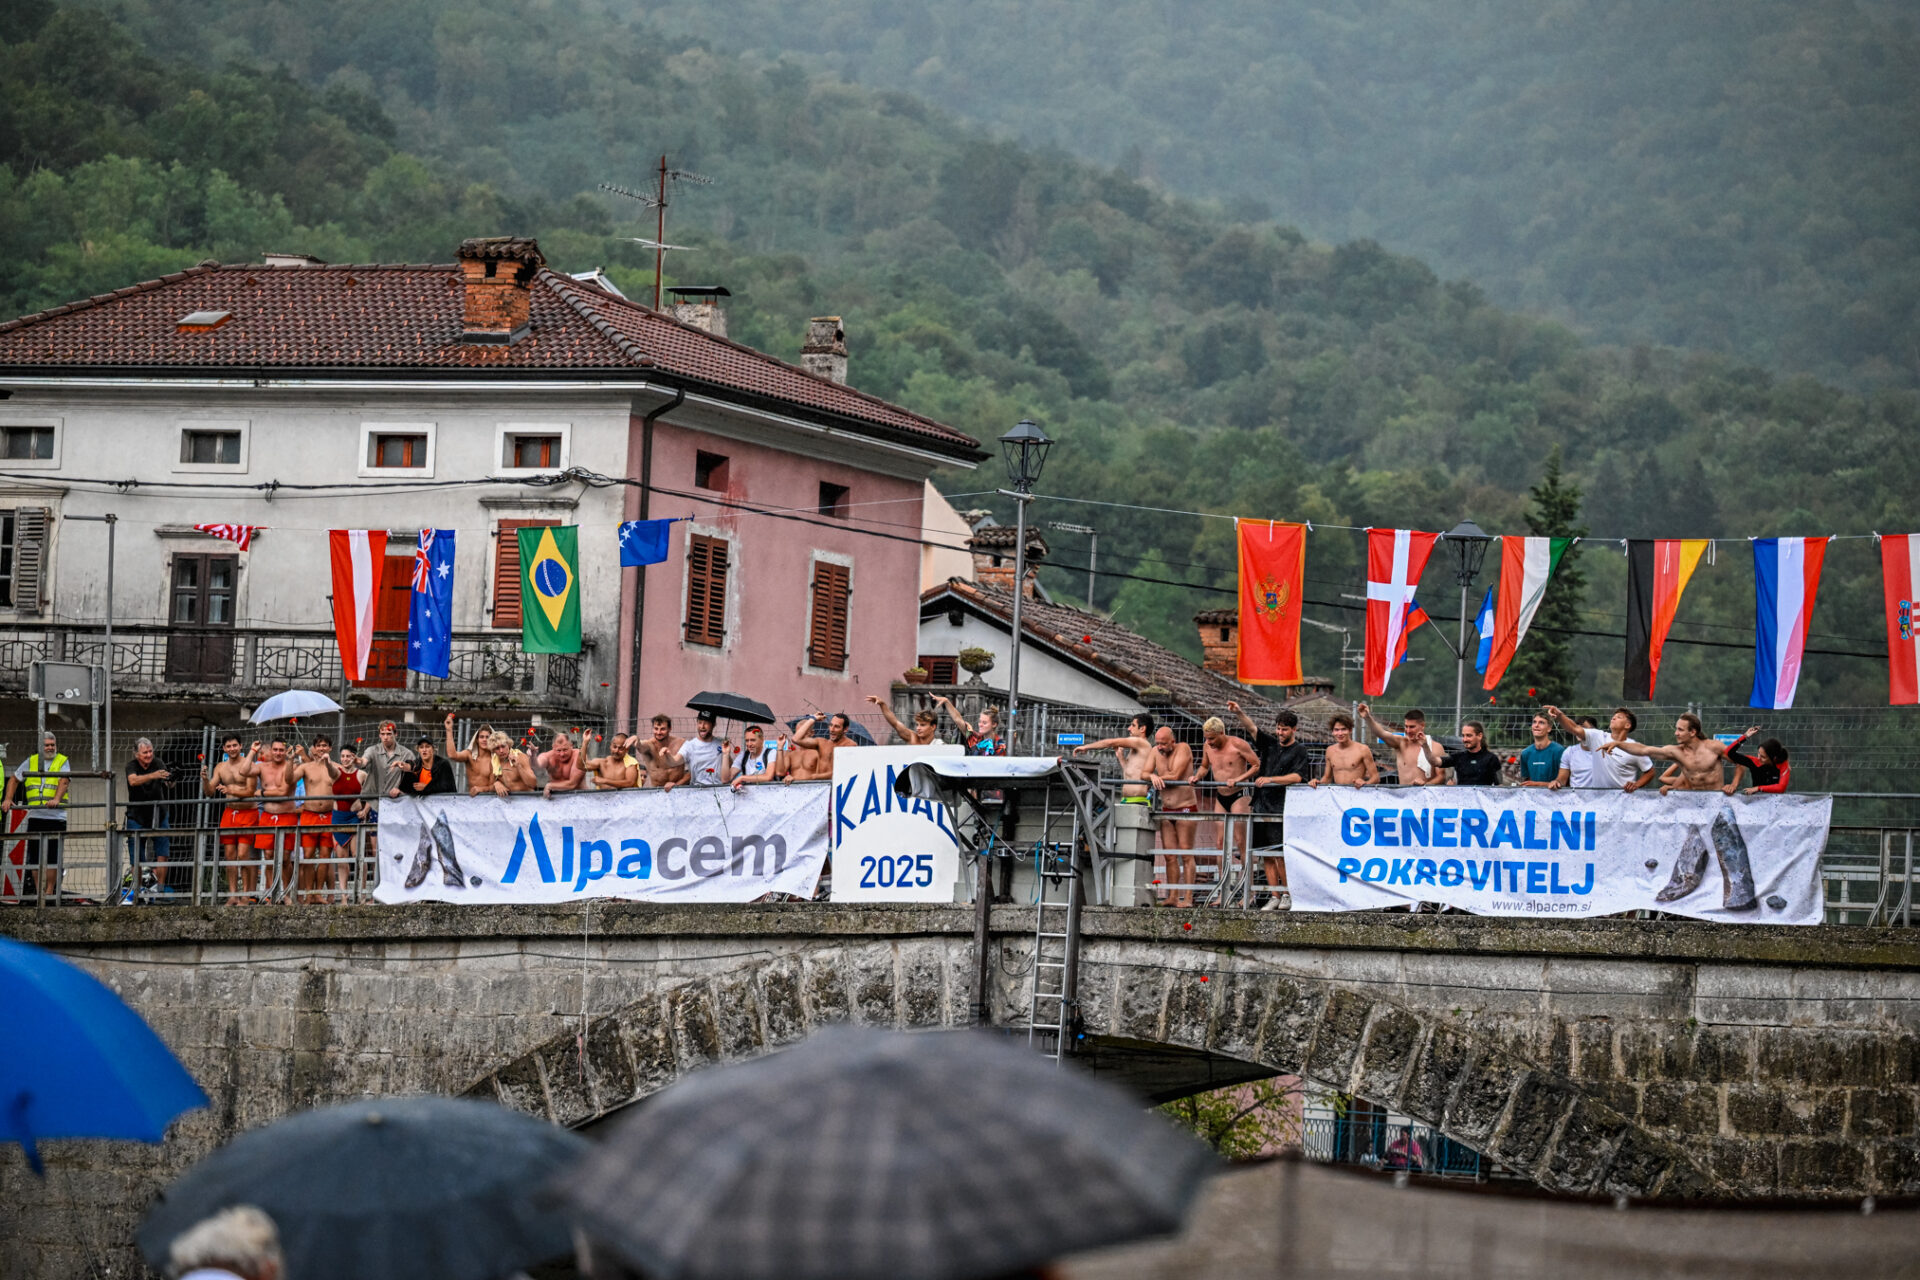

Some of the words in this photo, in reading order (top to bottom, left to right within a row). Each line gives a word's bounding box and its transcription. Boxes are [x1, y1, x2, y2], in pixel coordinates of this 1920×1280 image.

[1341, 807, 1596, 851] GENERALNI
[500, 811, 787, 892] Alpacem
[860, 855, 933, 888] 2025
[1337, 857, 1595, 895] POKROVITELJ
[1492, 899, 1592, 914] www.alpacem.si
